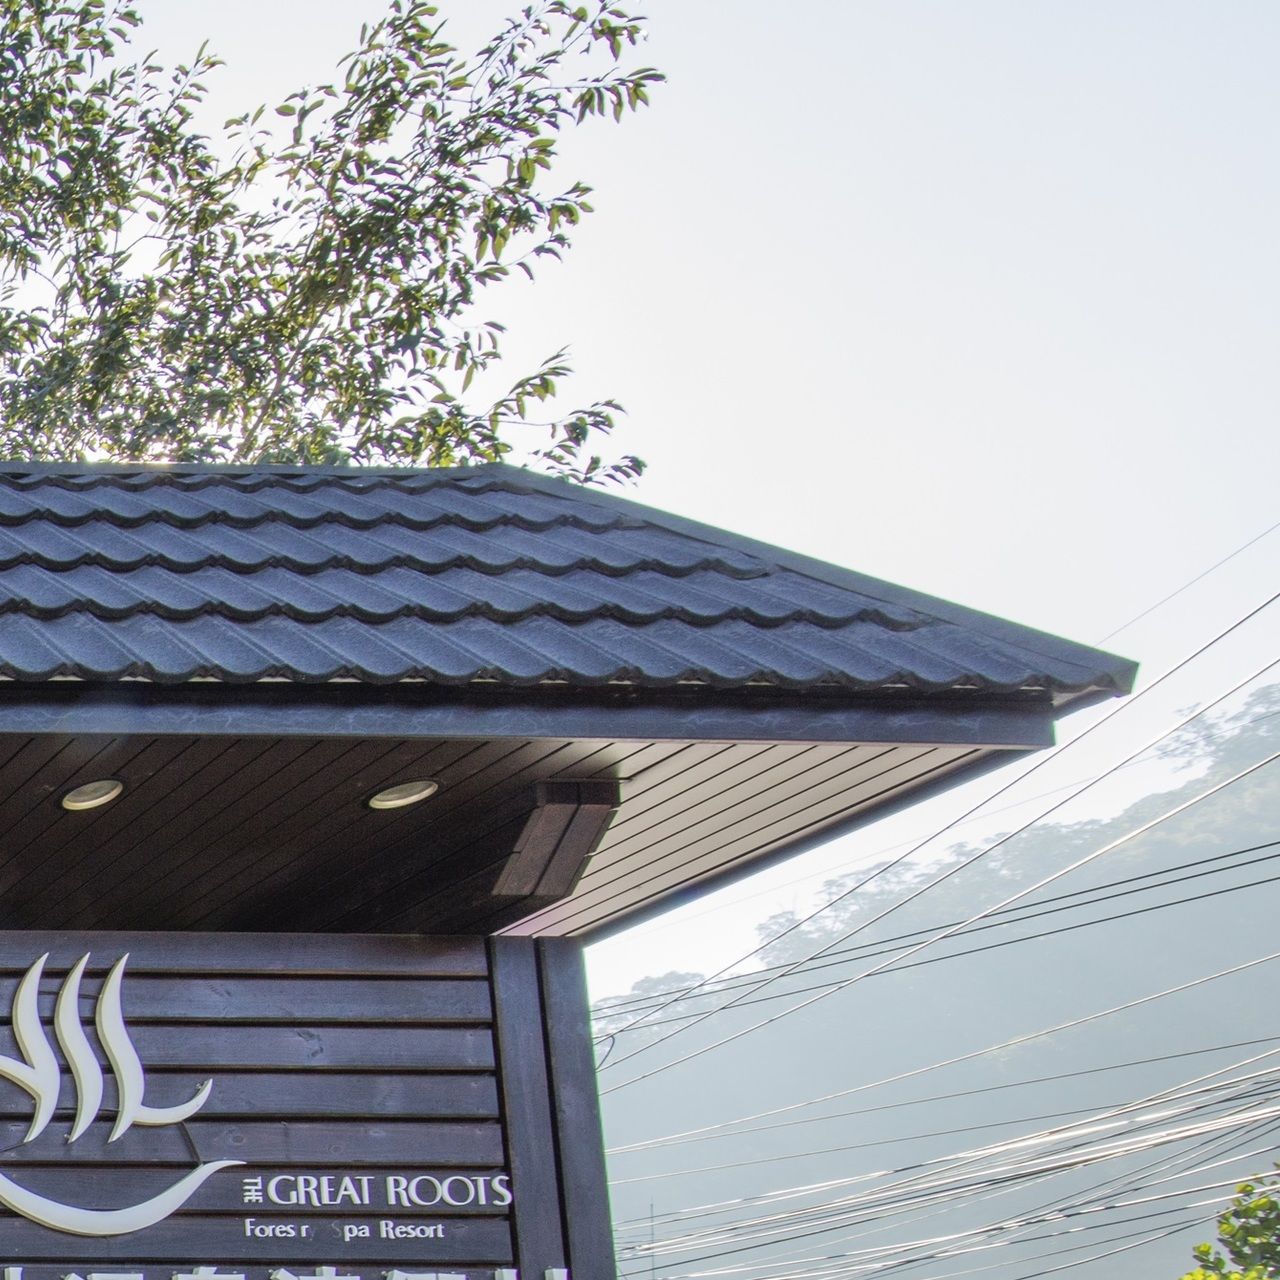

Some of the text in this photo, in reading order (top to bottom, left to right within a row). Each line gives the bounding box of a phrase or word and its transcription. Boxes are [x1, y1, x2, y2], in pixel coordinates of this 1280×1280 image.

[243, 1175, 513, 1206] THE GREAT ROOTS
[379, 1220, 444, 1240] Resort
